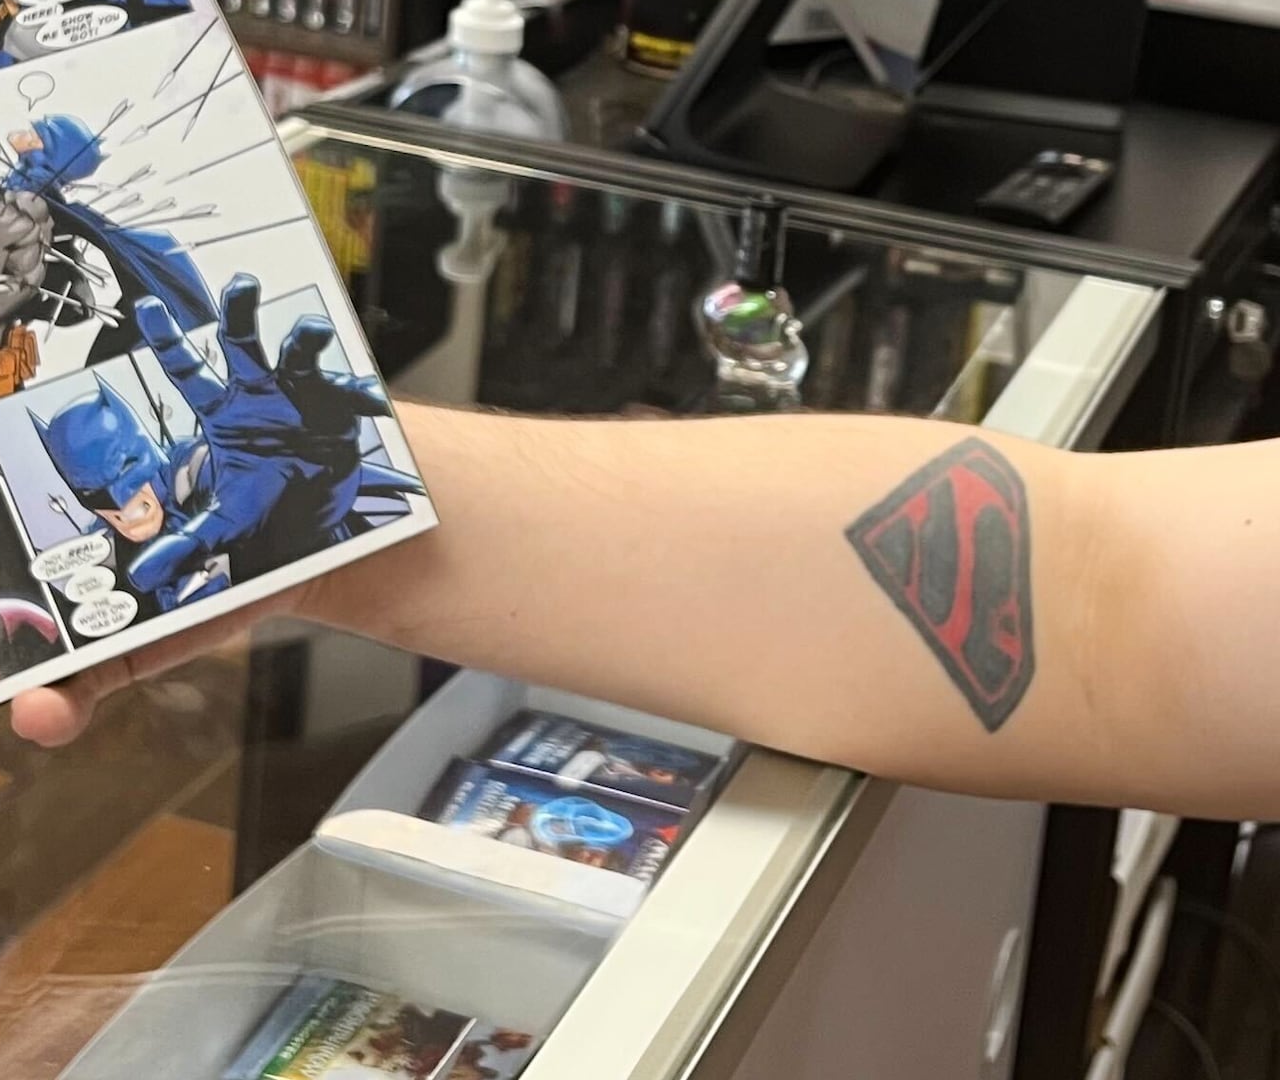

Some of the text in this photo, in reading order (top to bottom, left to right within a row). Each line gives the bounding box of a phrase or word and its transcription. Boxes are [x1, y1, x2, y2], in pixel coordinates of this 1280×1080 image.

[41, 13, 121, 42] ME WHAT YOU
[61, 11, 94, 26] SHOW
